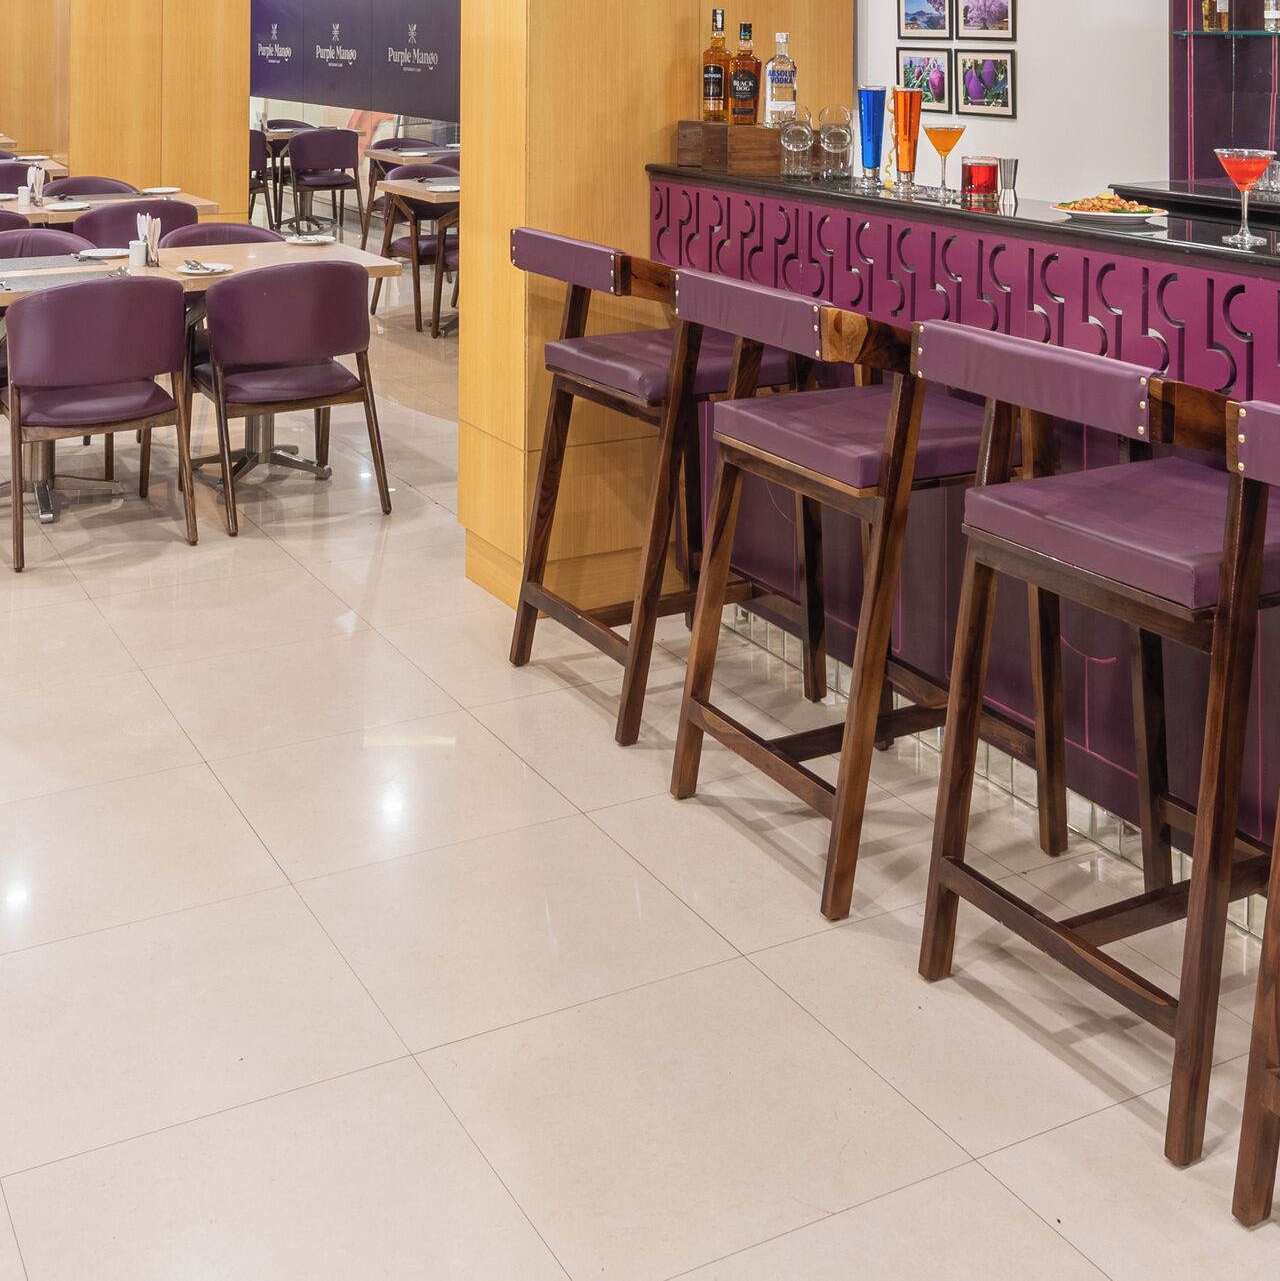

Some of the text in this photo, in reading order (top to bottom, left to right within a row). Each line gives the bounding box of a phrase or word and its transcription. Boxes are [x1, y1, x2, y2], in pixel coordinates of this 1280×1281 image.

[258, 43, 292, 62] Purple Mango
[316, 44, 356, 65] Purple Mango
[388, 47, 438, 70] Purple Mango
[768, 70, 796, 78] ABSOLUT
